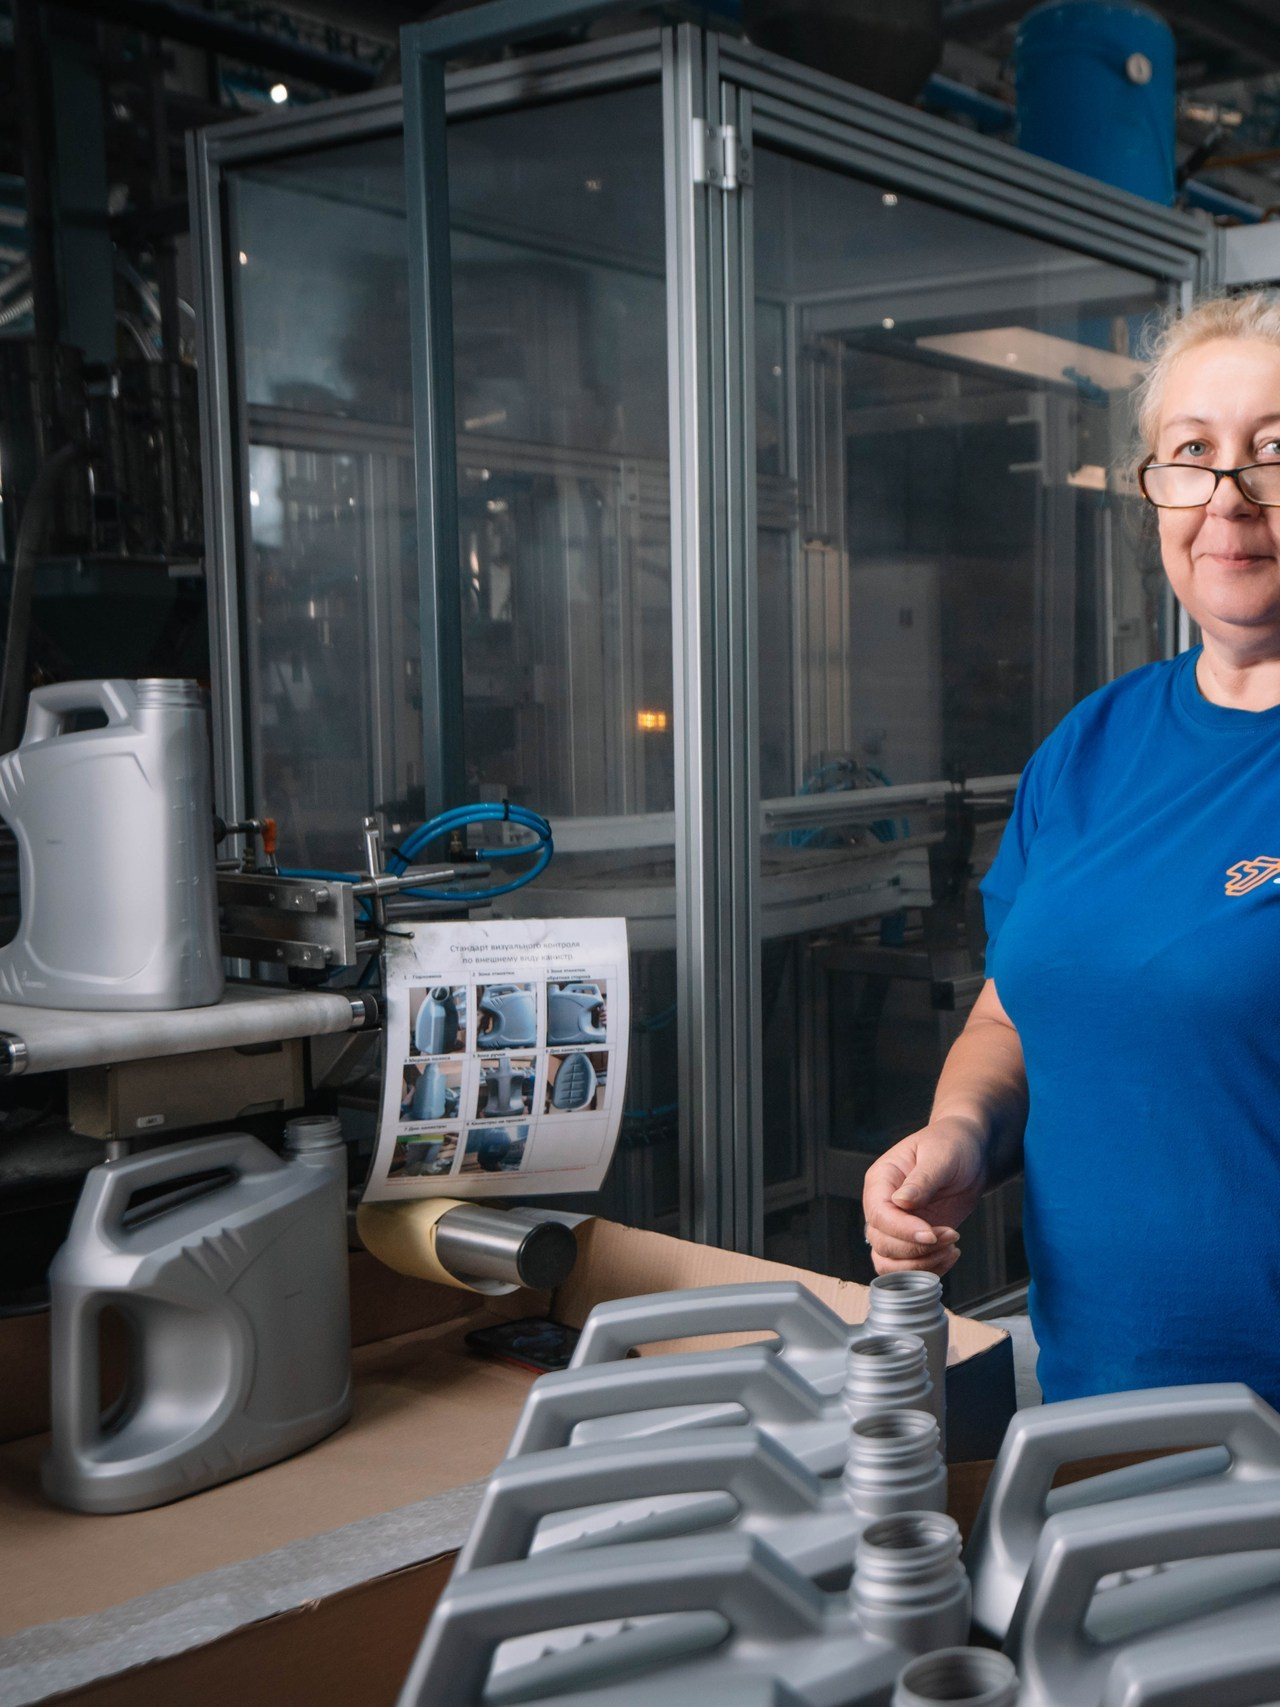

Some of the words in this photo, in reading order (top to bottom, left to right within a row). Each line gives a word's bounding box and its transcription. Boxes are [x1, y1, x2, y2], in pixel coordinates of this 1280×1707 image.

[449, 944, 489, 952] Стандарт
[490, 943, 542, 951] визуального
[475, 956, 518, 964] внешнему
